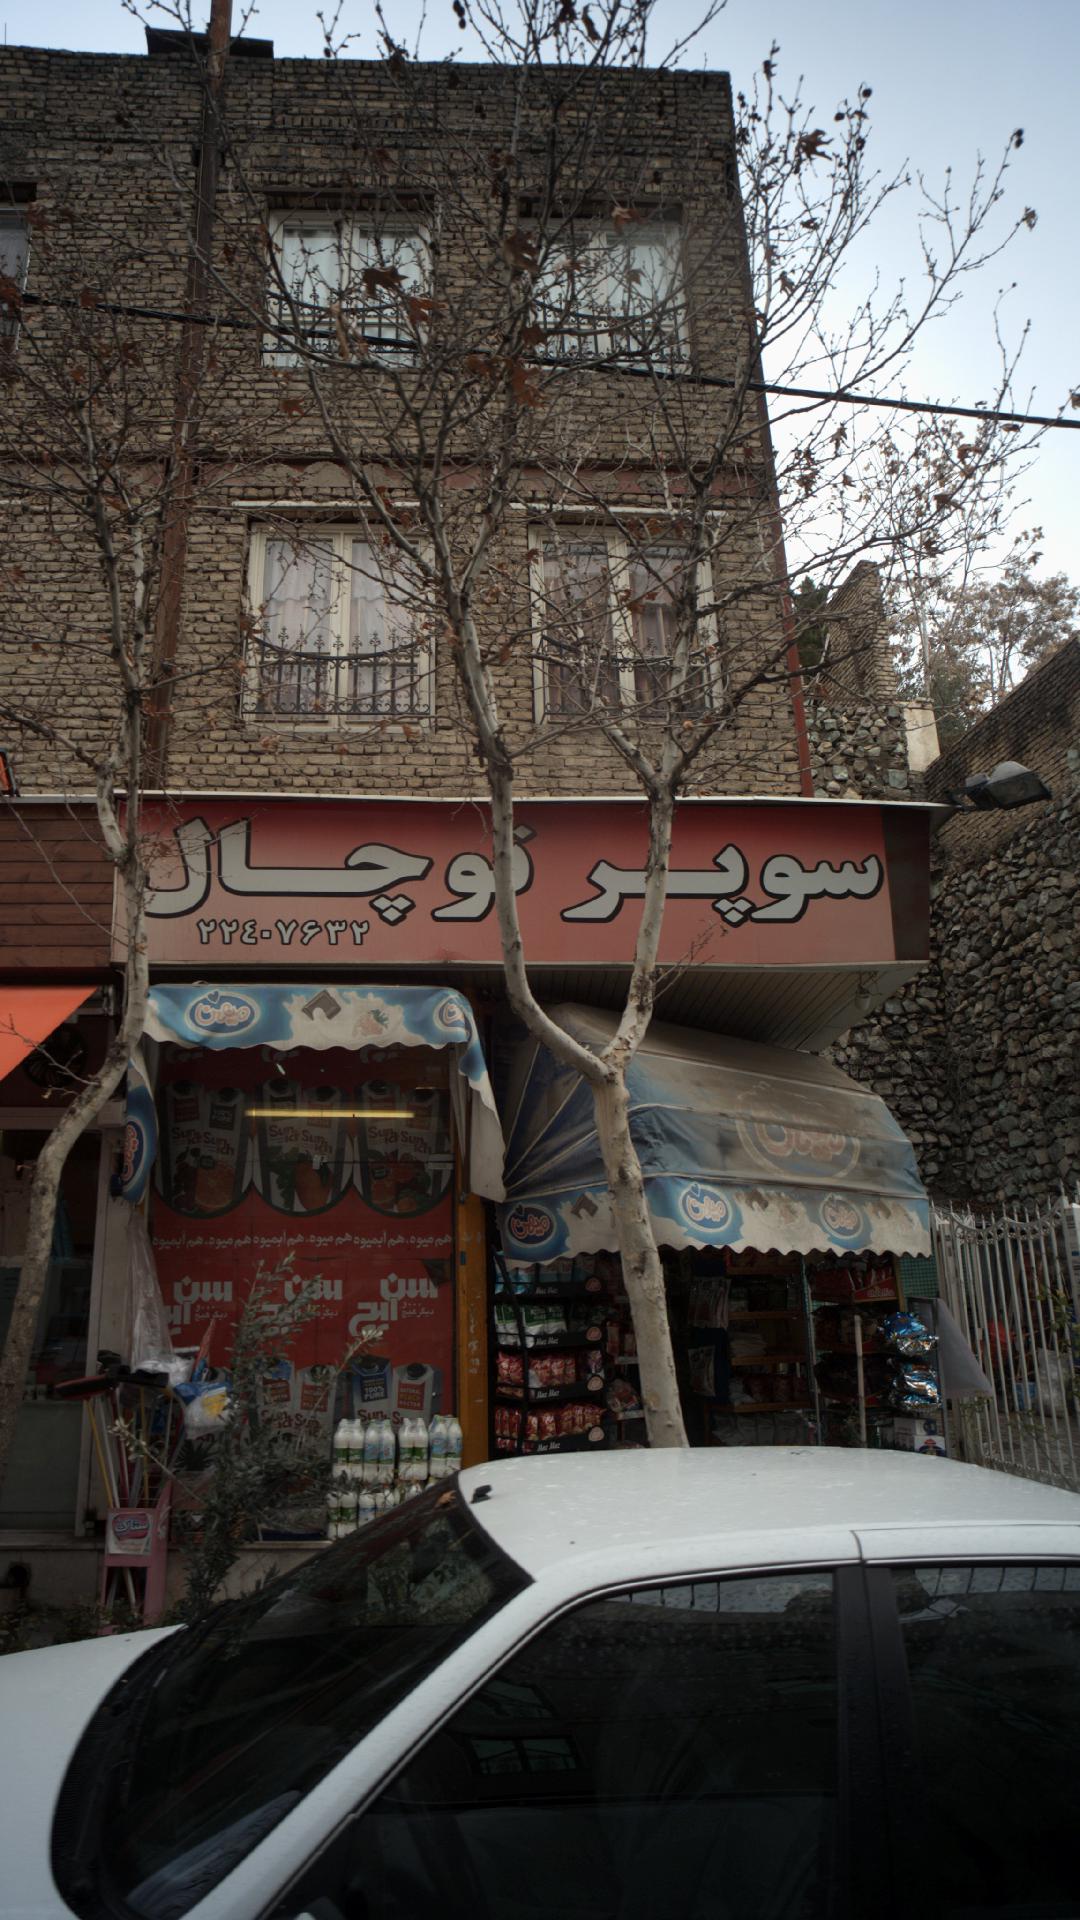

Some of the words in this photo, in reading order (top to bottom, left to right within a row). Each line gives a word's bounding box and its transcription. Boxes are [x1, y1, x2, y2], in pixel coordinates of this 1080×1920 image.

[560, 843, 884, 927] سوپر
[510, 1206, 551, 1238] میهن
[187, 1234, 204, 1248] هم
[234, 1233, 251, 1248] هم
[287, 1233, 305, 1248] هم
[335, 1231, 352, 1246] هم
[435, 1233, 452, 1247] هم
[173, 1274, 234, 1304] سن
[380, 1272, 439, 1301] سن
